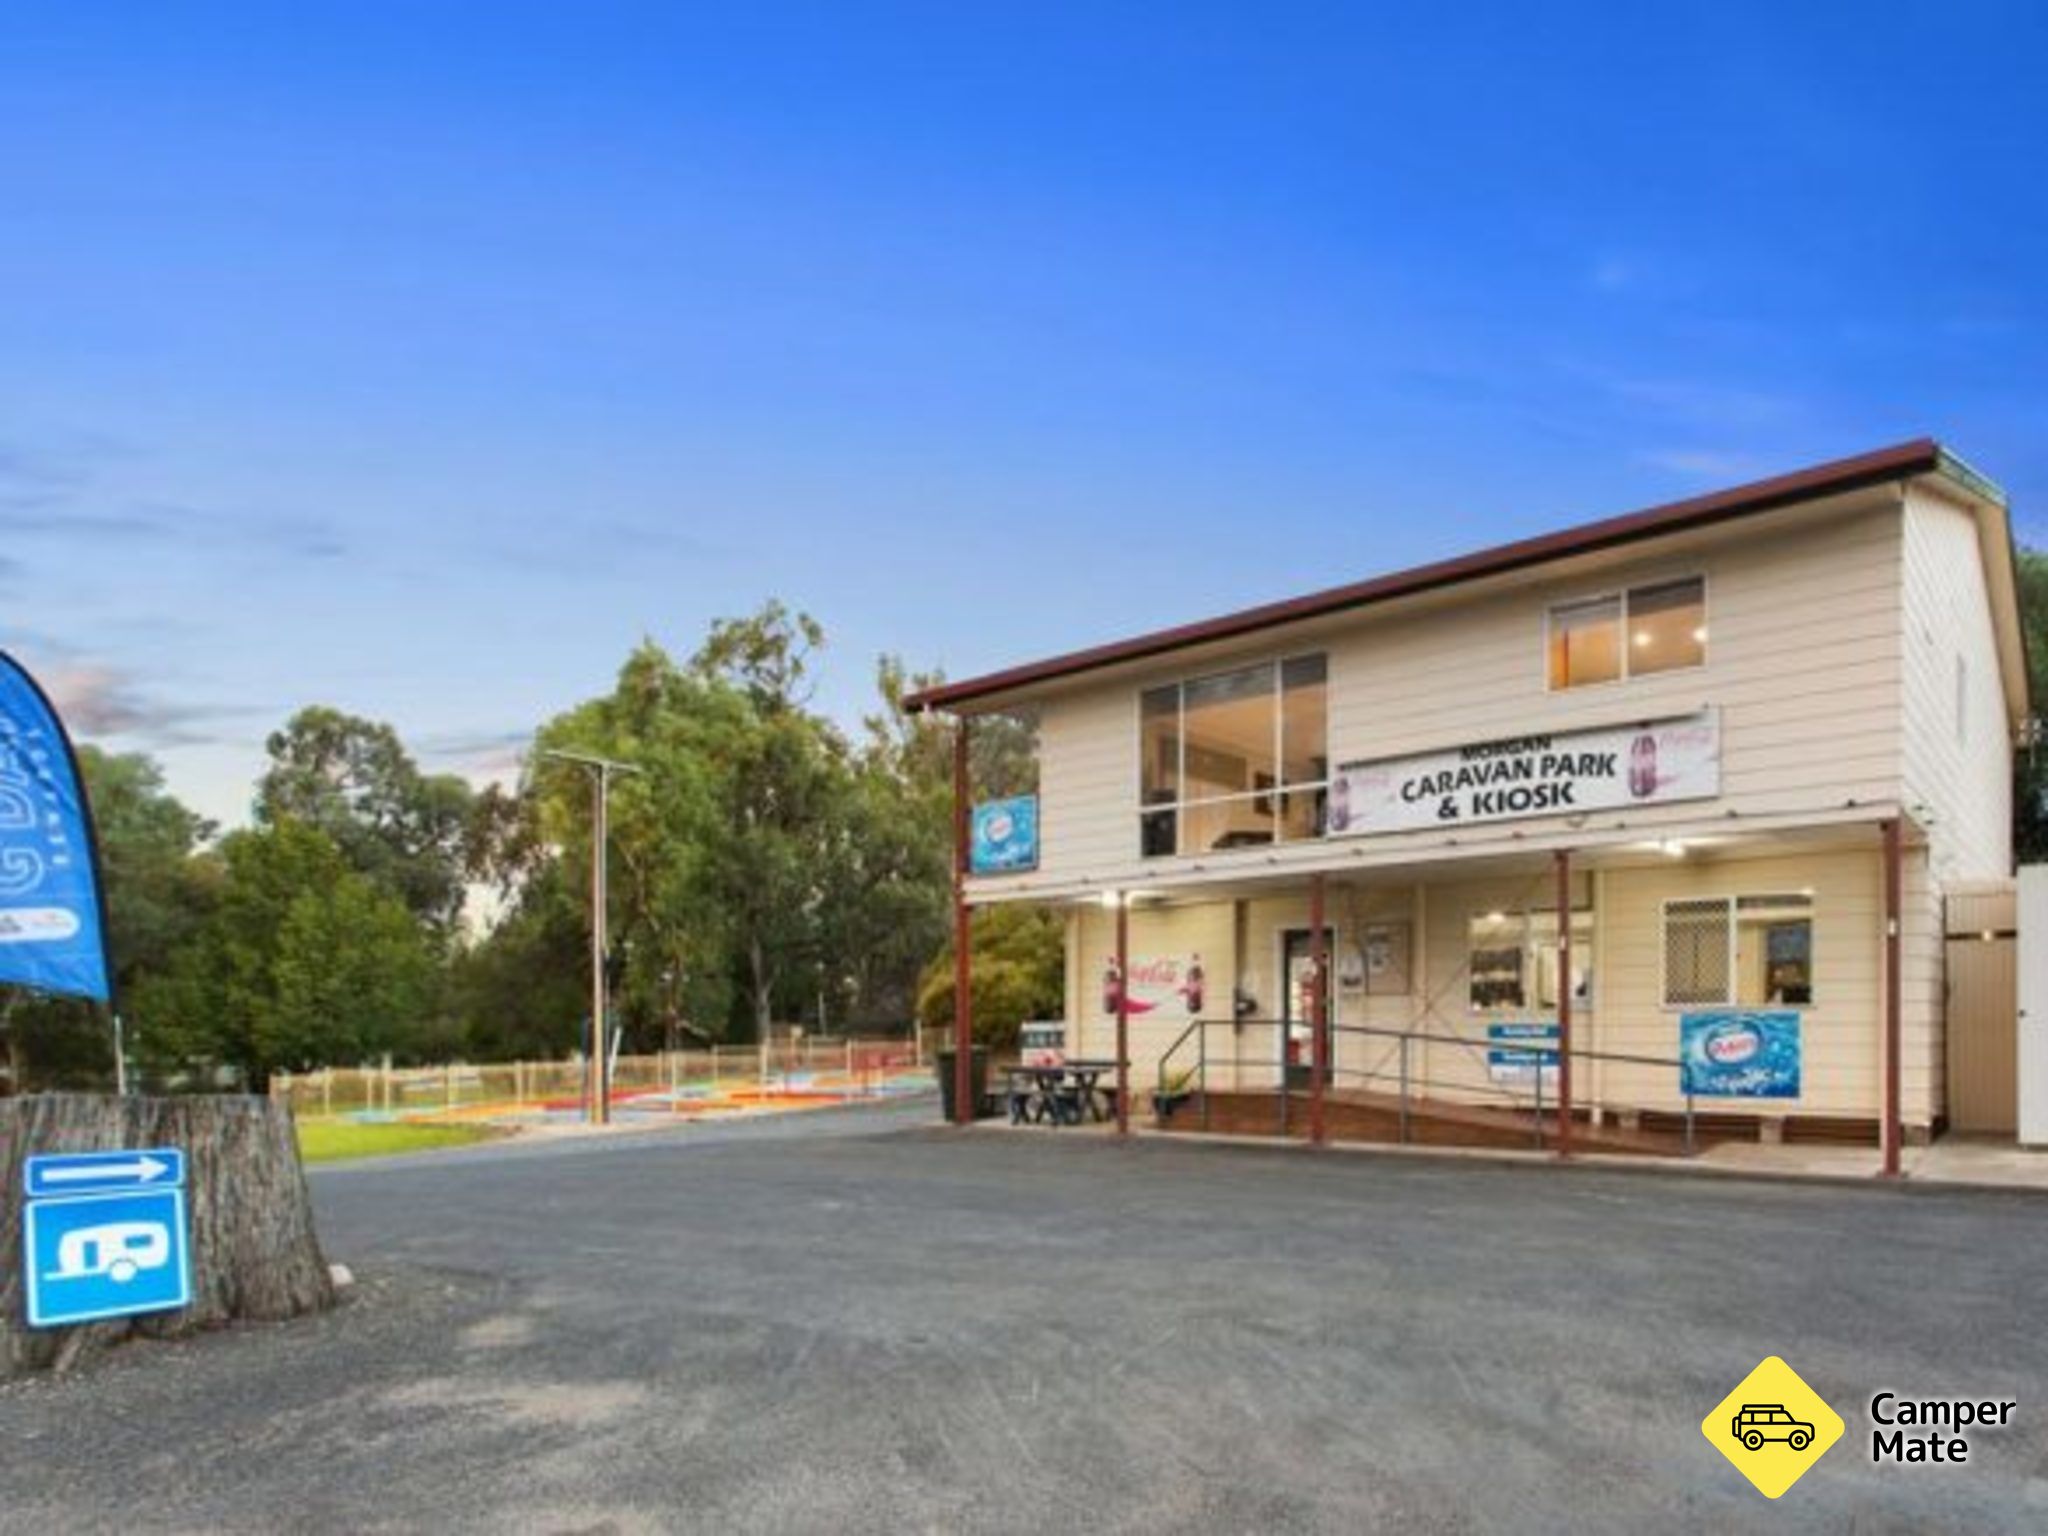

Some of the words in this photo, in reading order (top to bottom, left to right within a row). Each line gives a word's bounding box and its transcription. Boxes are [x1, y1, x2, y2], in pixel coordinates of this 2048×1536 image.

[1460, 735, 1552, 761] MORGAN
[1402, 757, 1533, 803] CARAVAN
[1540, 753, 1617, 778] PARK
[1437, 796, 1458, 819] &
[1473, 781, 1575, 815] KIOSK
